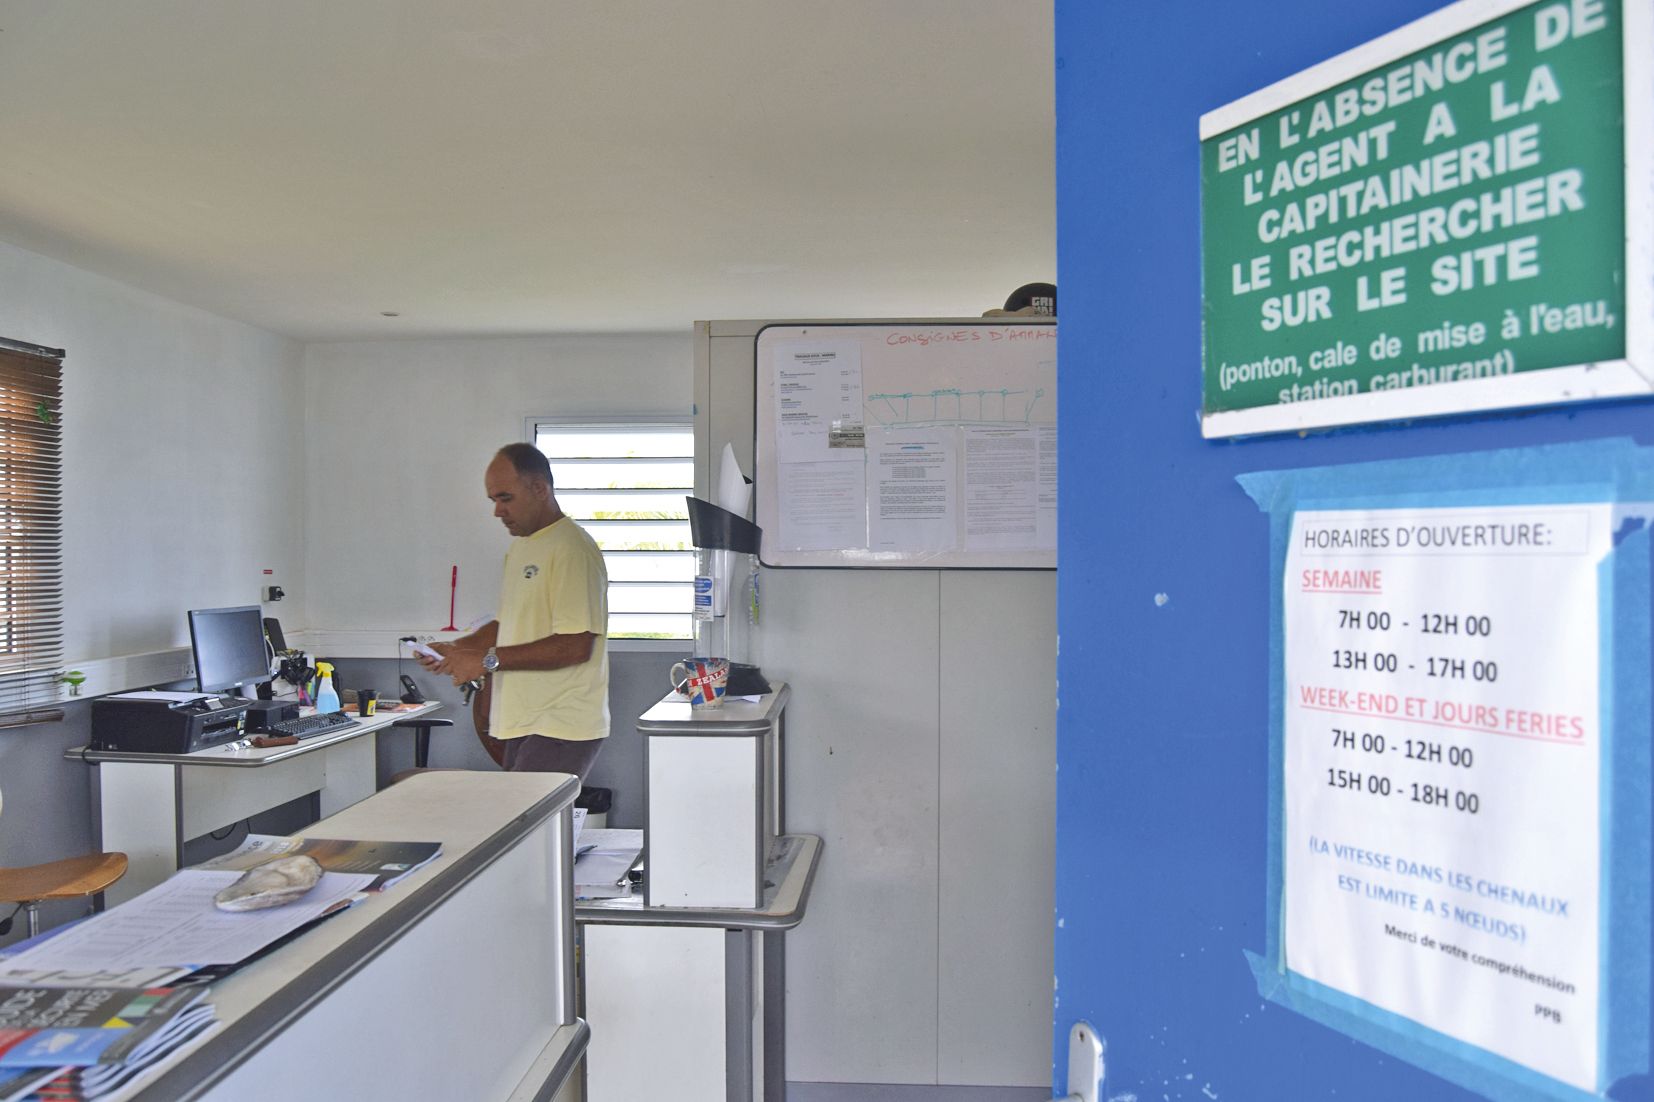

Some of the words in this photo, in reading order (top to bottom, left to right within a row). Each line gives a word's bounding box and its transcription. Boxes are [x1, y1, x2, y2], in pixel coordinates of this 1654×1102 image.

[1218, 128, 1260, 172] EN
[1279, 27, 1508, 149] L'ABSENCE
[1534, 0, 1606, 53] DE
[1243, 121, 1396, 206] L'AGENT
[1423, 101, 1457, 144] A
[1490, 65, 1561, 122] LA
[1258, 123, 1541, 243] CAPITAINERIE
[1232, 254, 1271, 295] LE
[1288, 168, 1584, 281] RECHERCHER
[1260, 285, 1332, 332] SUR
[1356, 267, 1407, 312] LE
[1430, 235, 1539, 296] SITE
[1219, 355, 1303, 391] (ponton,
[1309, 341, 1358, 371] cale
[1369, 333, 1402, 361] de
[1417, 320, 1486, 354] mise
[1501, 309, 1521, 340] à
[1530, 300, 1615, 336] l'eau,
[1278, 378, 1359, 405] station
[1369, 349, 1516, 393] carburant)
[1304, 528, 1391, 549] HORAIRES
[1396, 523, 1553, 548] D'OUVERTURE:
[1302, 569, 1383, 591] SEMAINE
[1338, 610, 1361, 630] 7H
[1367, 611, 1391, 631] 00
[1420, 614, 1458, 635] 12H
[1465, 615, 1491, 636] 00
[1332, 650, 1367, 671] 13H
[1374, 652, 1398, 673] 00
[1426, 657, 1465, 680] 17H
[1473, 660, 1498, 682] 00
[1300, 686, 1399, 714] WEEK-END
[1404, 697, 1426, 718] ET
[1433, 700, 1499, 728] JOURS
[1505, 709, 1584, 739] FERIES
[1331, 729, 1355, 750] 7H
[1362, 733, 1385, 754] 00
[1404, 740, 1442, 762] 12H
[1448, 746, 1473, 768] 00
[1327, 768, 1361, 790] 15H
[1368, 776, 1391, 797] 00
[1411, 783, 1449, 807] 18H
[1455, 792, 1479, 814] 00
[1309, 835, 1329, 856] (LA
[1333, 843, 1391, 872] VITESSE
[1396, 858, 1443, 883] DANS
[1448, 870, 1473, 893] LES
[1476, 880, 1569, 917] CHENAUX
[1338, 875, 1361, 893] EST
[1366, 882, 1418, 911] LIMITE
[1423, 898, 1435, 916] A
[1440, 902, 1450, 918] 5
[1385, 923, 1418, 944] Merci
[1421, 934, 1436, 949] de
[1439, 942, 1469, 961] votre
[1471, 952, 1575, 996] compréhension
[1534, 1004, 1562, 1024] PPB
